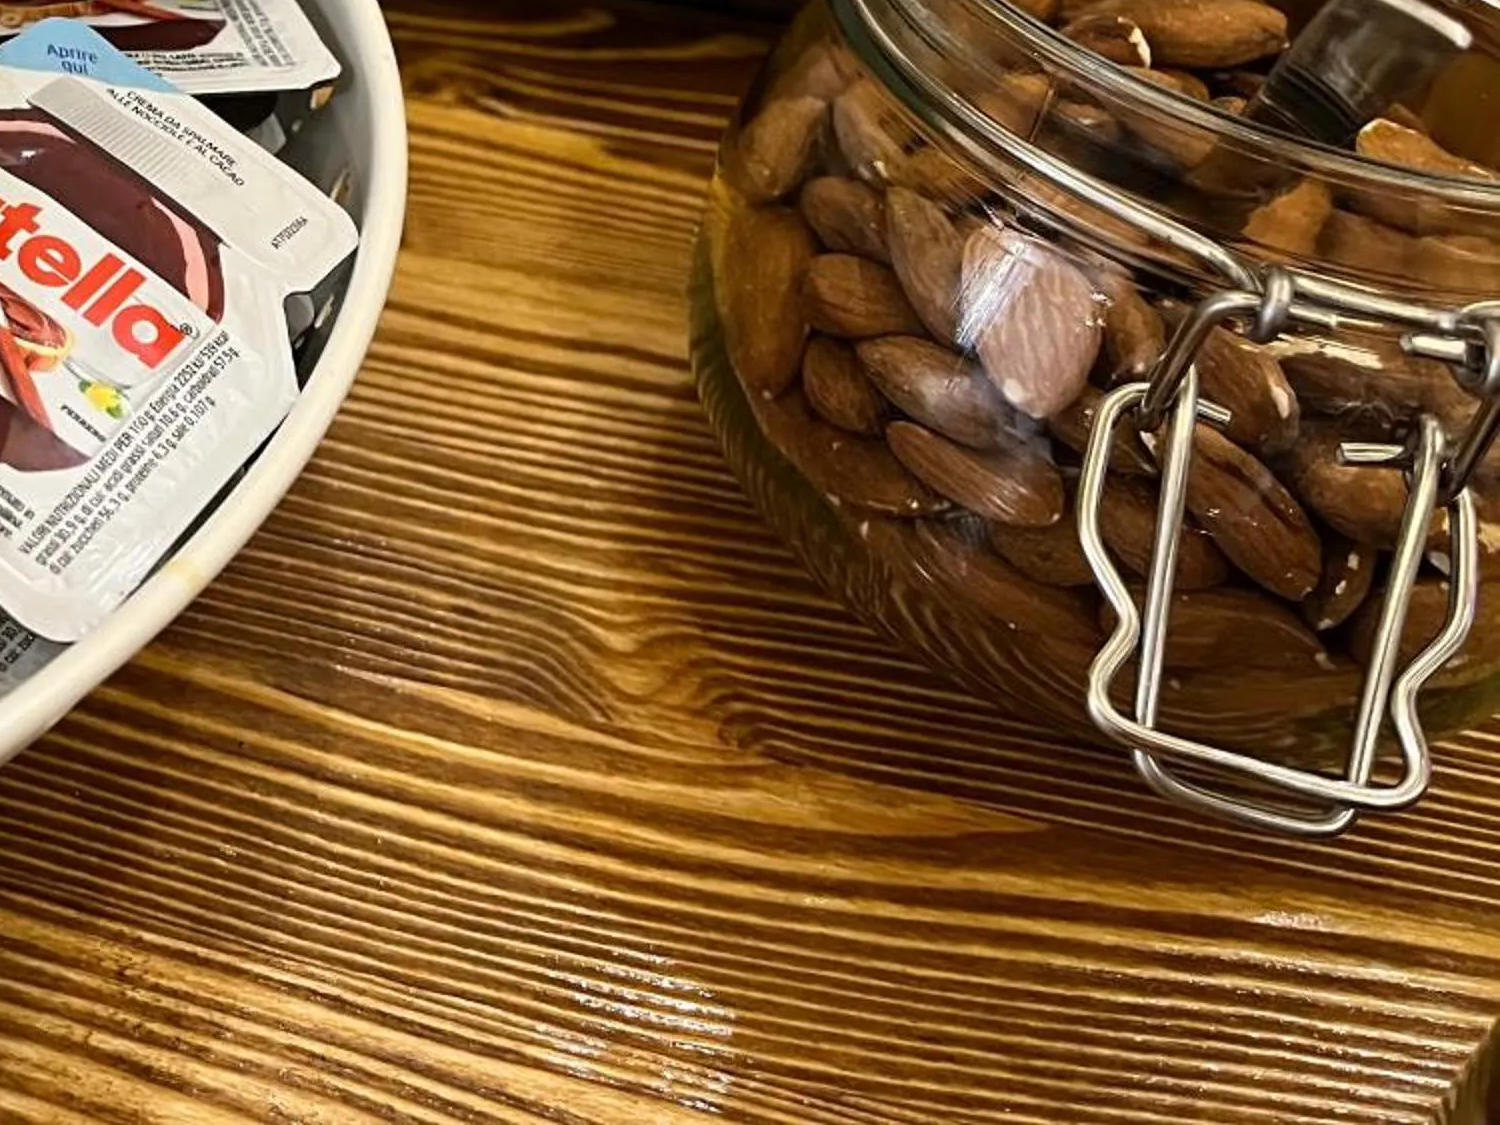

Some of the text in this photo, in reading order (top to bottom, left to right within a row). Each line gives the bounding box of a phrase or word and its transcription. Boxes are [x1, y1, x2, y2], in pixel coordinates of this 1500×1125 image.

[46, 42, 100, 64] Aprire
[61, 60, 90, 76] qui
[105, 85, 132, 109] ALLE
[130, 99, 186, 146] NOCCIOLE
[209, 156, 247, 188] CACAO
[125, 87, 165, 121] CREMA
[180, 122, 238, 169] SPALMARE
[94, 446, 120, 473] MEDI
[113, 430, 135, 453] PER
[148, 381, 182, 415] Energia
